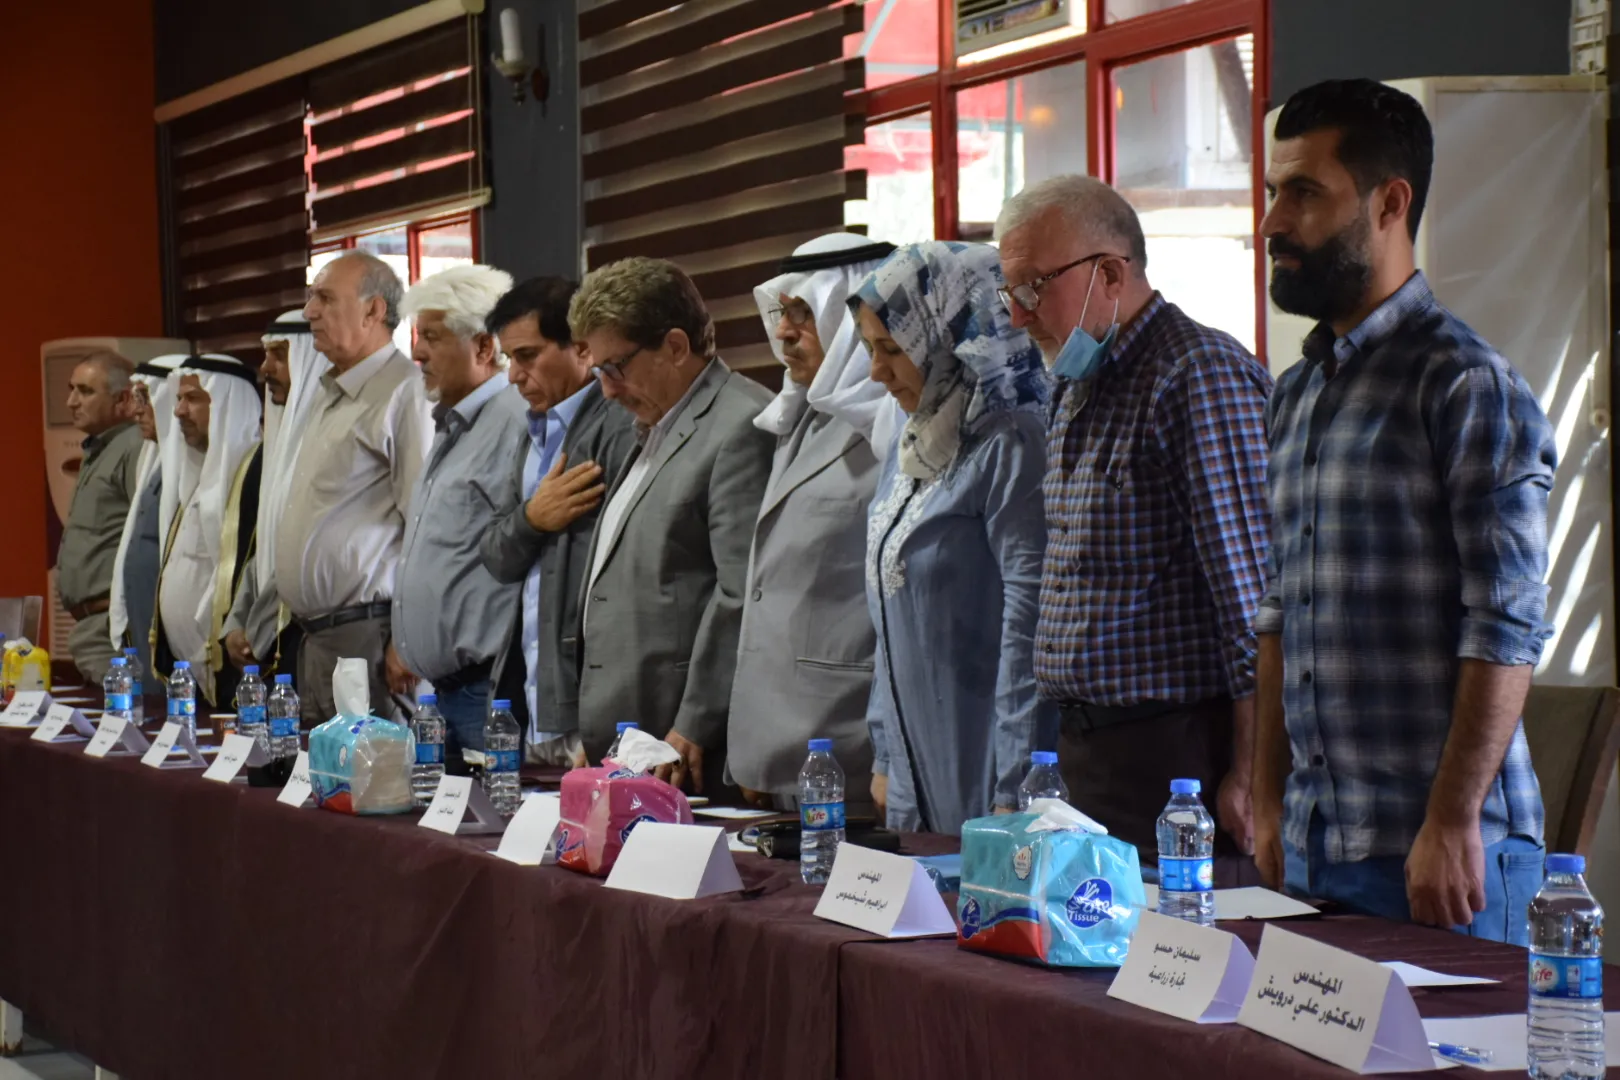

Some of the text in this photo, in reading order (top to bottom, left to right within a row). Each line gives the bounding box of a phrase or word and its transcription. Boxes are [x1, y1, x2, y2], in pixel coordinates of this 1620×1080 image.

[857, 871, 883, 884] المهندس
[1067, 909, 1100, 923] Tissue
[1153, 943, 1201, 963] سليمان حسو
[1293, 971, 1343, 996] المهندس
[1257, 974, 1366, 1033] الدكتور علي درويش
